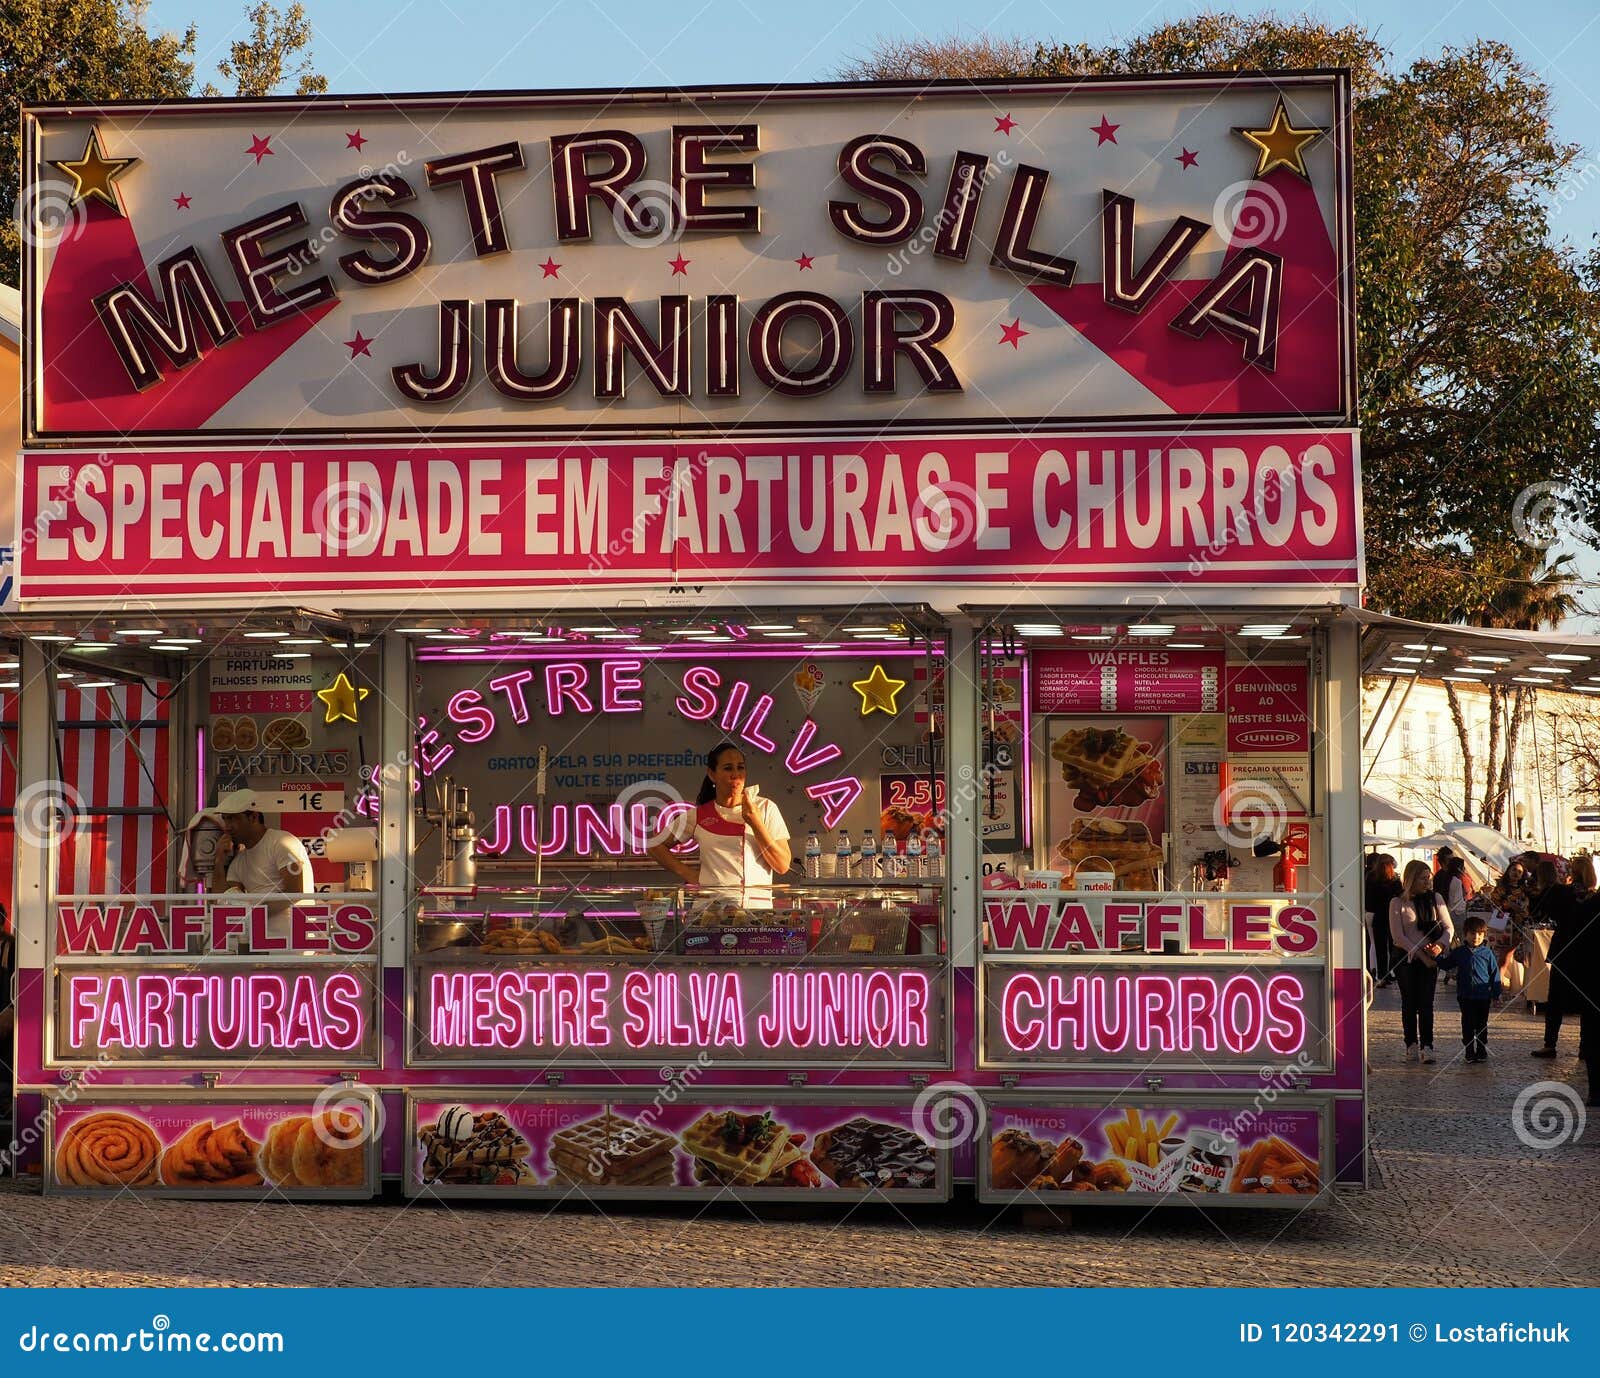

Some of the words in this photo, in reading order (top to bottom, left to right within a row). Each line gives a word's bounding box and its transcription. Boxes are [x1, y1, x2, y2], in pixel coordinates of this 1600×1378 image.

[92, 124, 761, 392] MESTRE
[827, 134, 1283, 371] SILVA
[392, 289, 966, 402] JUNIOR
[36, 458, 502, 562] ESPECIALIDADE
[525, 456, 608, 556] EM
[633, 451, 953, 556] FARTURAS
[976, 451, 1010, 551] E
[1032, 444, 1339, 549] CHURROS
[226, 660, 295, 671] FARTURAS
[1088, 652, 1170, 665] WAFFLES
[212, 676, 258, 685] FILHOSES
[262, 675, 312, 684] FARTURAS
[1235, 684, 1297, 692] BENVINDOS
[1258, 697, 1274, 705] AO
[1229, 715, 1272, 723] MESTRE
[1275, 714, 1306, 722] SILVA
[1240, 734, 1297, 742] JUNIOR
[675, 666, 865, 830] SILVA
[216, 753, 349, 777] FARTURAS
[488, 757, 546, 770] GRATO
[550, 755, 588, 769] PELA
[593, 754, 623, 767] SUA
[555, 774, 600, 788] VOLTE
[299, 793, 323, 811] 1€
[1084, 883, 1112, 891] nutella
[58, 905, 376, 953] WAFFLES
[987, 904, 1320, 952] WAFFLES
[69, 974, 364, 1050] FARTURAS
[430, 971, 611, 1049] MESTRE
[623, 971, 745, 1049] SILVA
[758, 971, 930, 1049] JUNIOR
[1002, 973, 1306, 1055] CHURROS
[149, 1116, 198, 1128] Farturas
[507, 1108, 581, 1127] Waffles
[1003, 1113, 1067, 1130] Churros
[1184, 1161, 1227, 1179] nutella
